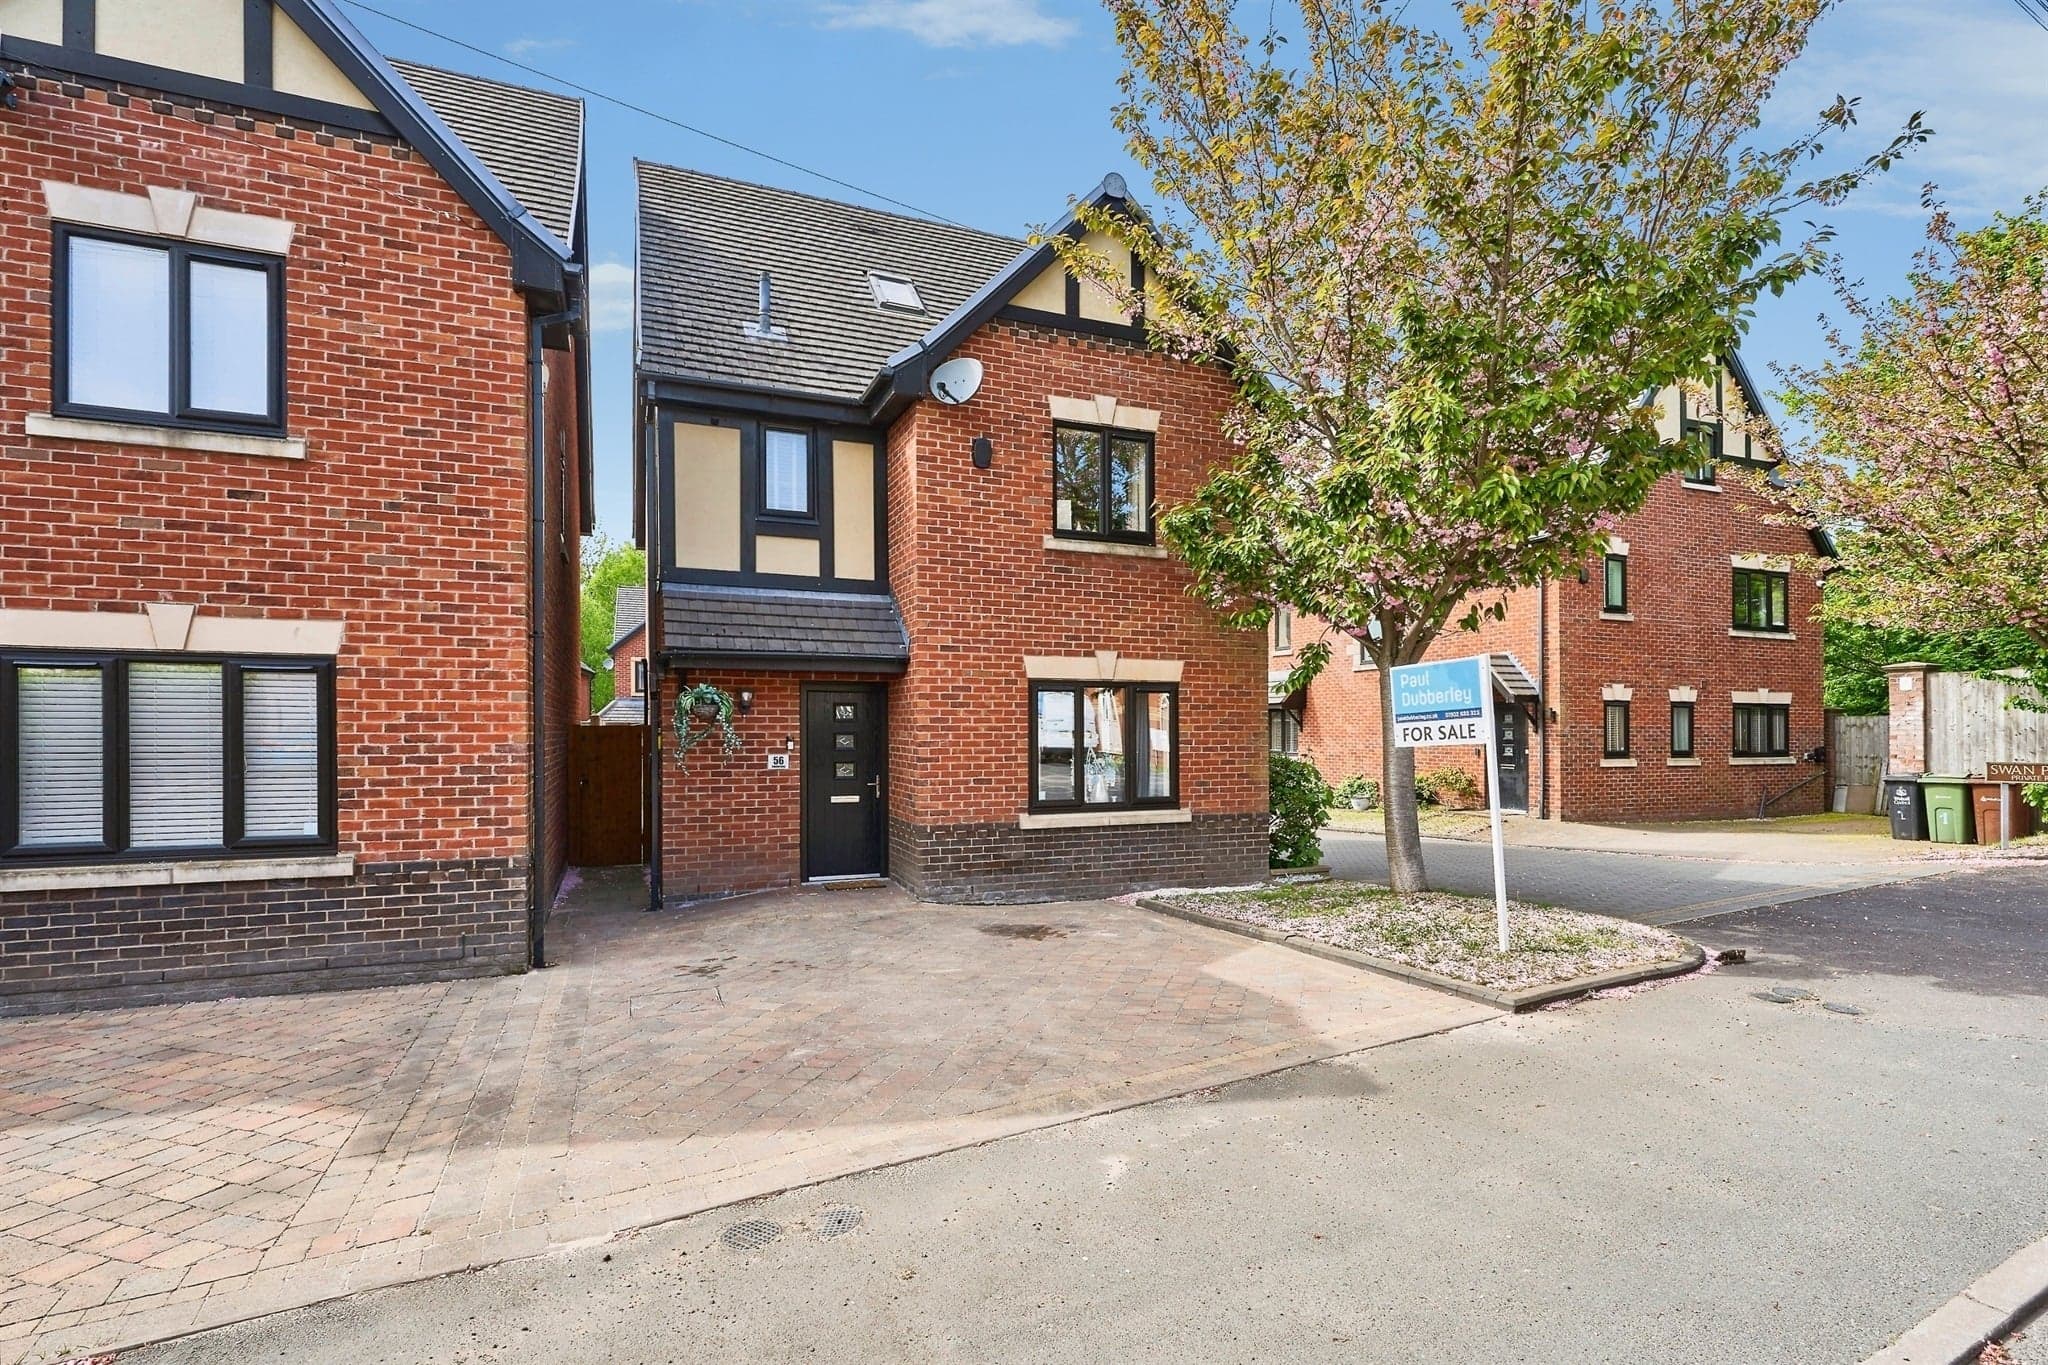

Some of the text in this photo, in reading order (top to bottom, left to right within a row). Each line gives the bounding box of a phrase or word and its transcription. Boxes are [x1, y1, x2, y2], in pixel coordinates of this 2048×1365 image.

[1400, 671, 1430, 688] Paul
[1402, 688, 1472, 706] Dubberley
[1402, 723, 1476, 742] FOR SALE
[773, 756, 784, 765] 56
[1990, 764, 2035, 775] SWAN
